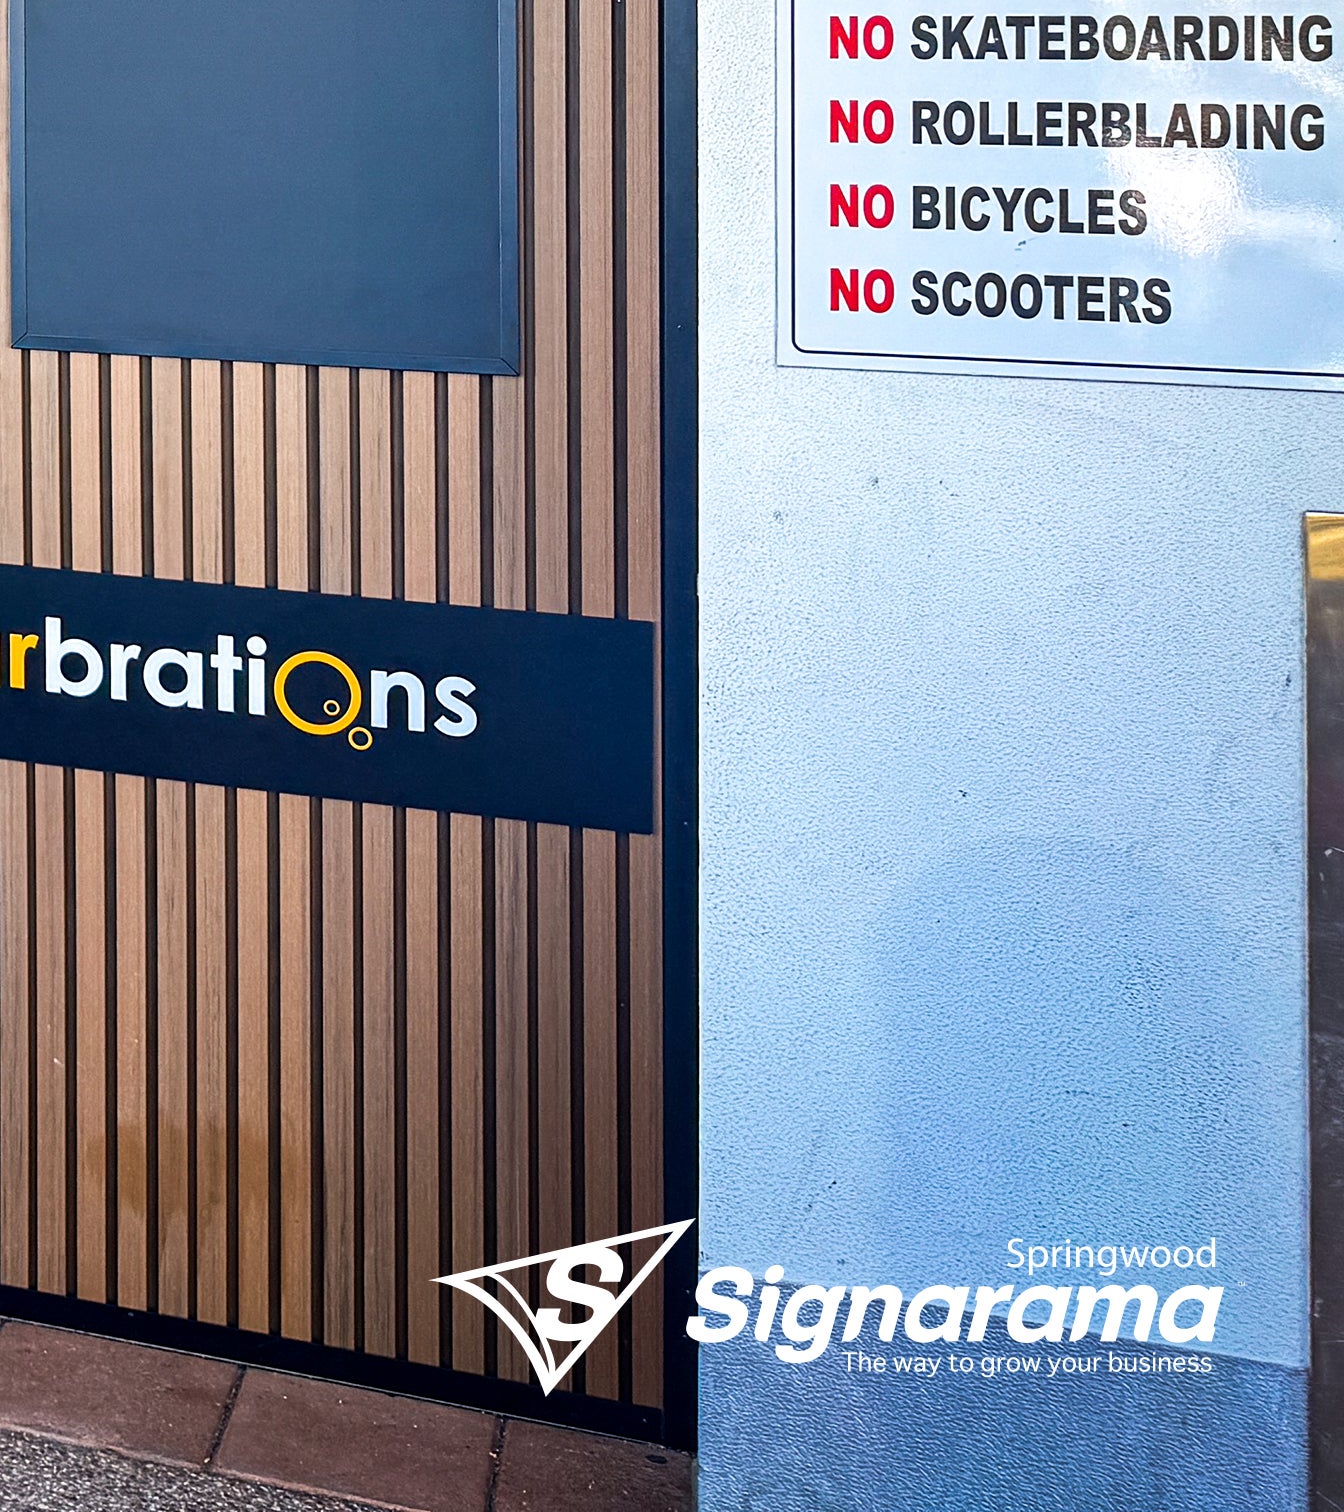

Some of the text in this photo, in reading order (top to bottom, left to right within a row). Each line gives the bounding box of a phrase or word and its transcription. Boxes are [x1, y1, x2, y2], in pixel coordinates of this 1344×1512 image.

[829, 16, 1334, 64] NO SKATEBOARDING
[829, 100, 1326, 152] NO ROLLERBLADING
[829, 184, 1147, 237] NO BICYCLES
[829, 268, 1173, 325] NO SCOOTERS
